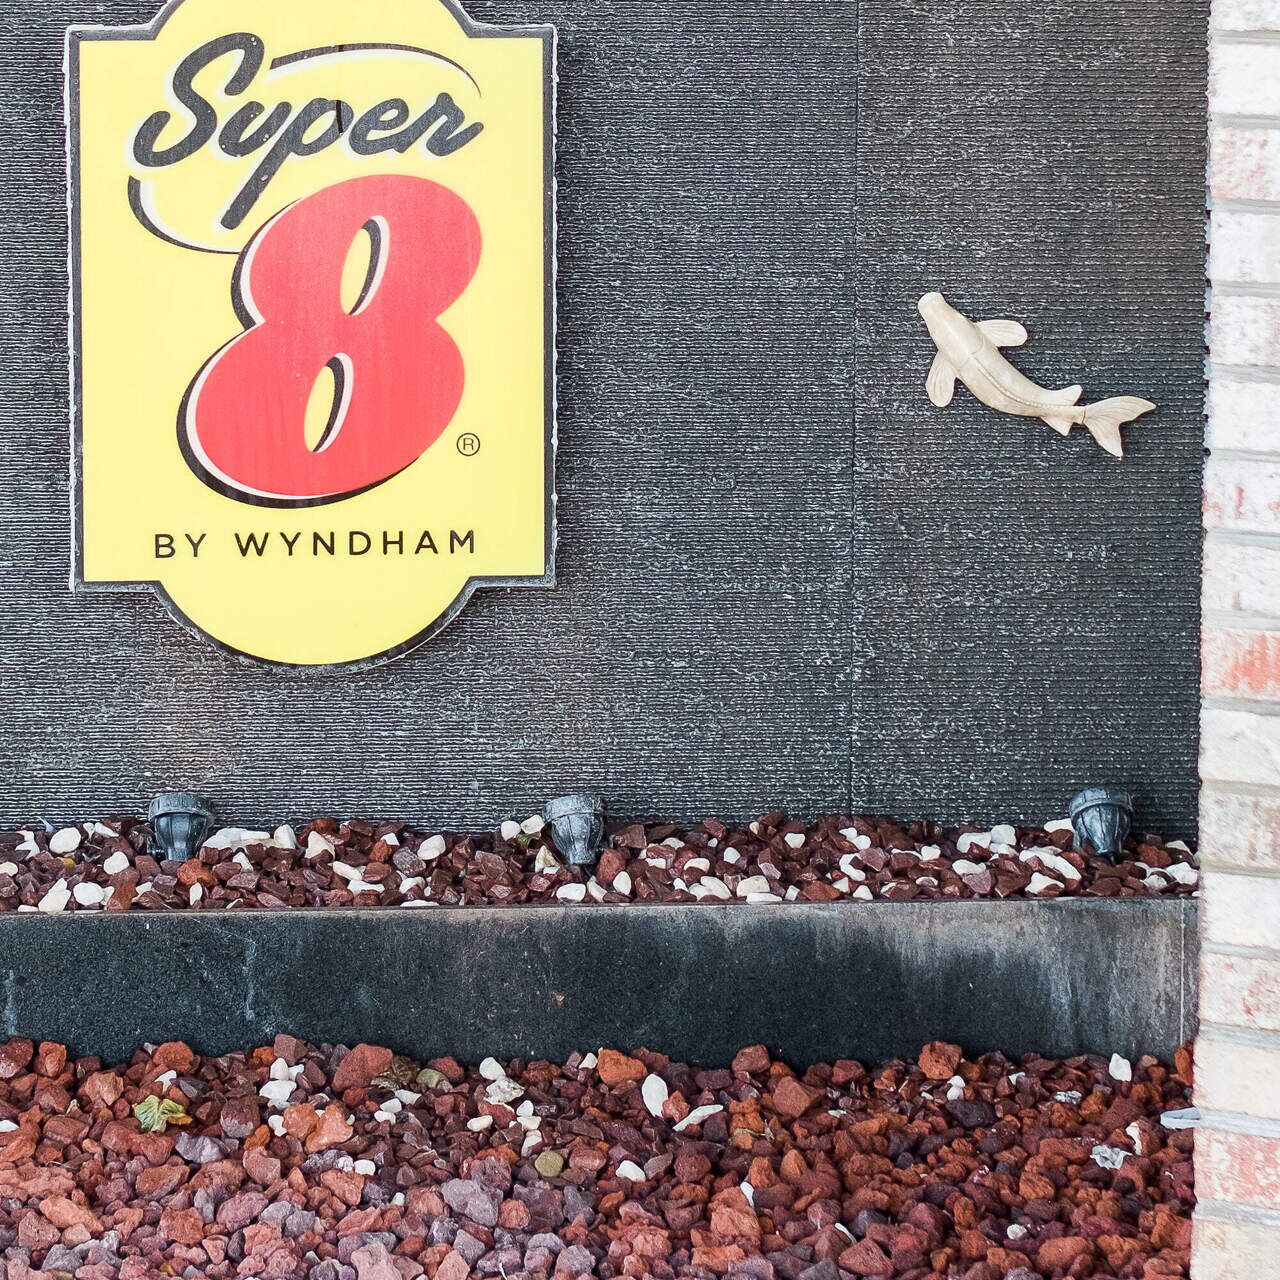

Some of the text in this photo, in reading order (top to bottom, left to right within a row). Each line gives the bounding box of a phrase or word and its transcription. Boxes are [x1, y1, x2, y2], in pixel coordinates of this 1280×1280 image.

[132, 32, 484, 229] Super
[176, 174, 483, 508] 8
[155, 530, 476, 559] BY WYNDHAM
